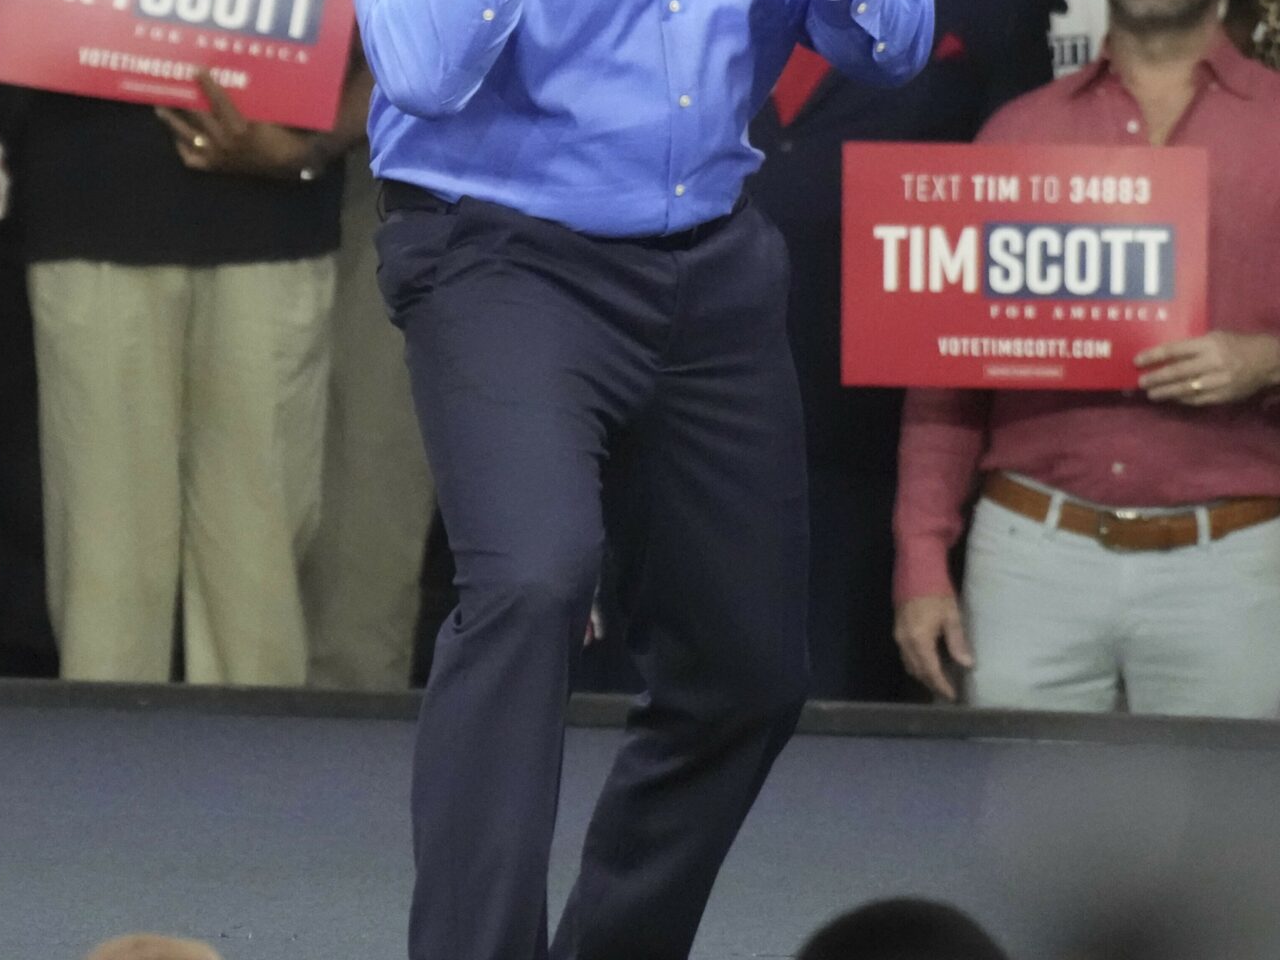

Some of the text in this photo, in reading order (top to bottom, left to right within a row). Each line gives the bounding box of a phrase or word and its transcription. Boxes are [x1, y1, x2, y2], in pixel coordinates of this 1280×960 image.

[901, 173, 1152, 205] TEXT TIM TO 34883
[873, 225, 1170, 296] TIM SCOTT
[990, 304, 1169, 321] FOR AMERICA
[937, 336, 1112, 359] VOTETIMSCOTT.COM
